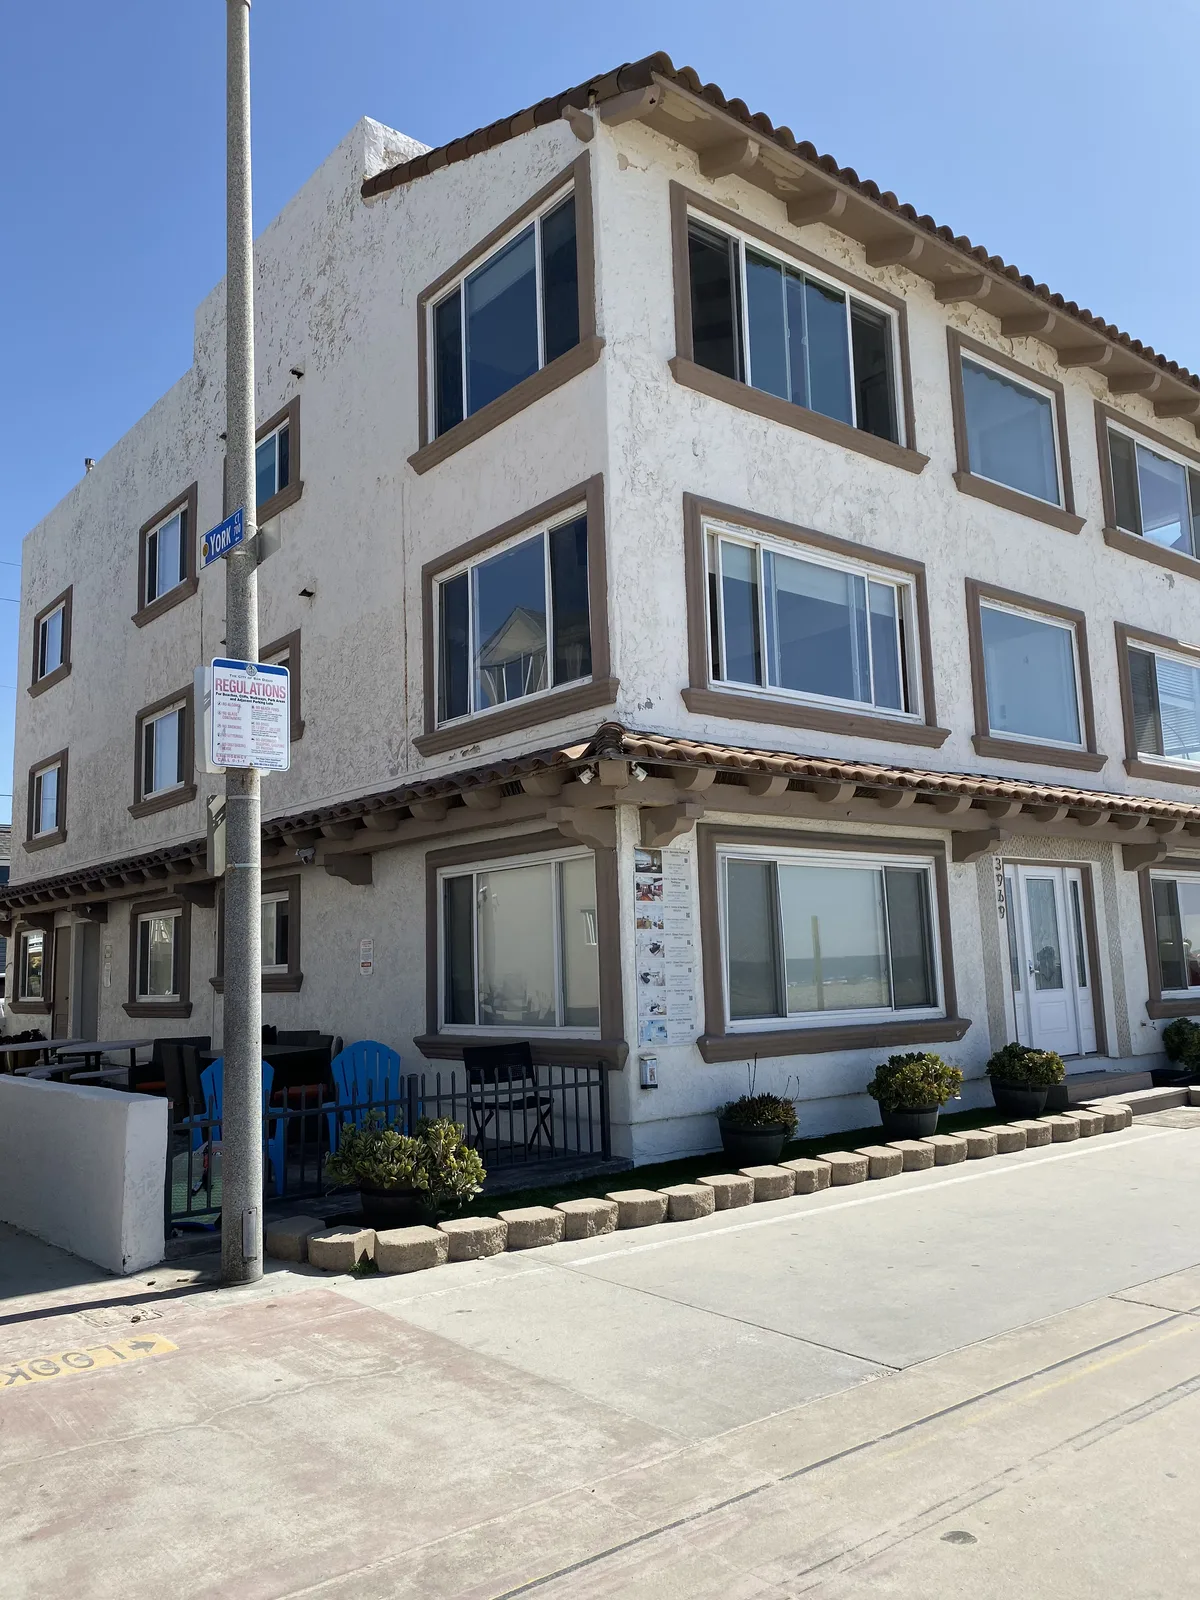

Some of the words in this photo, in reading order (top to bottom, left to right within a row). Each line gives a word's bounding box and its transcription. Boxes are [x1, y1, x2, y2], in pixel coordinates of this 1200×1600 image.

[210, 525, 231, 556] YORK
[215, 678, 286, 699] REGULATIONS
[4, 1344, 127, 1386] LOOK
